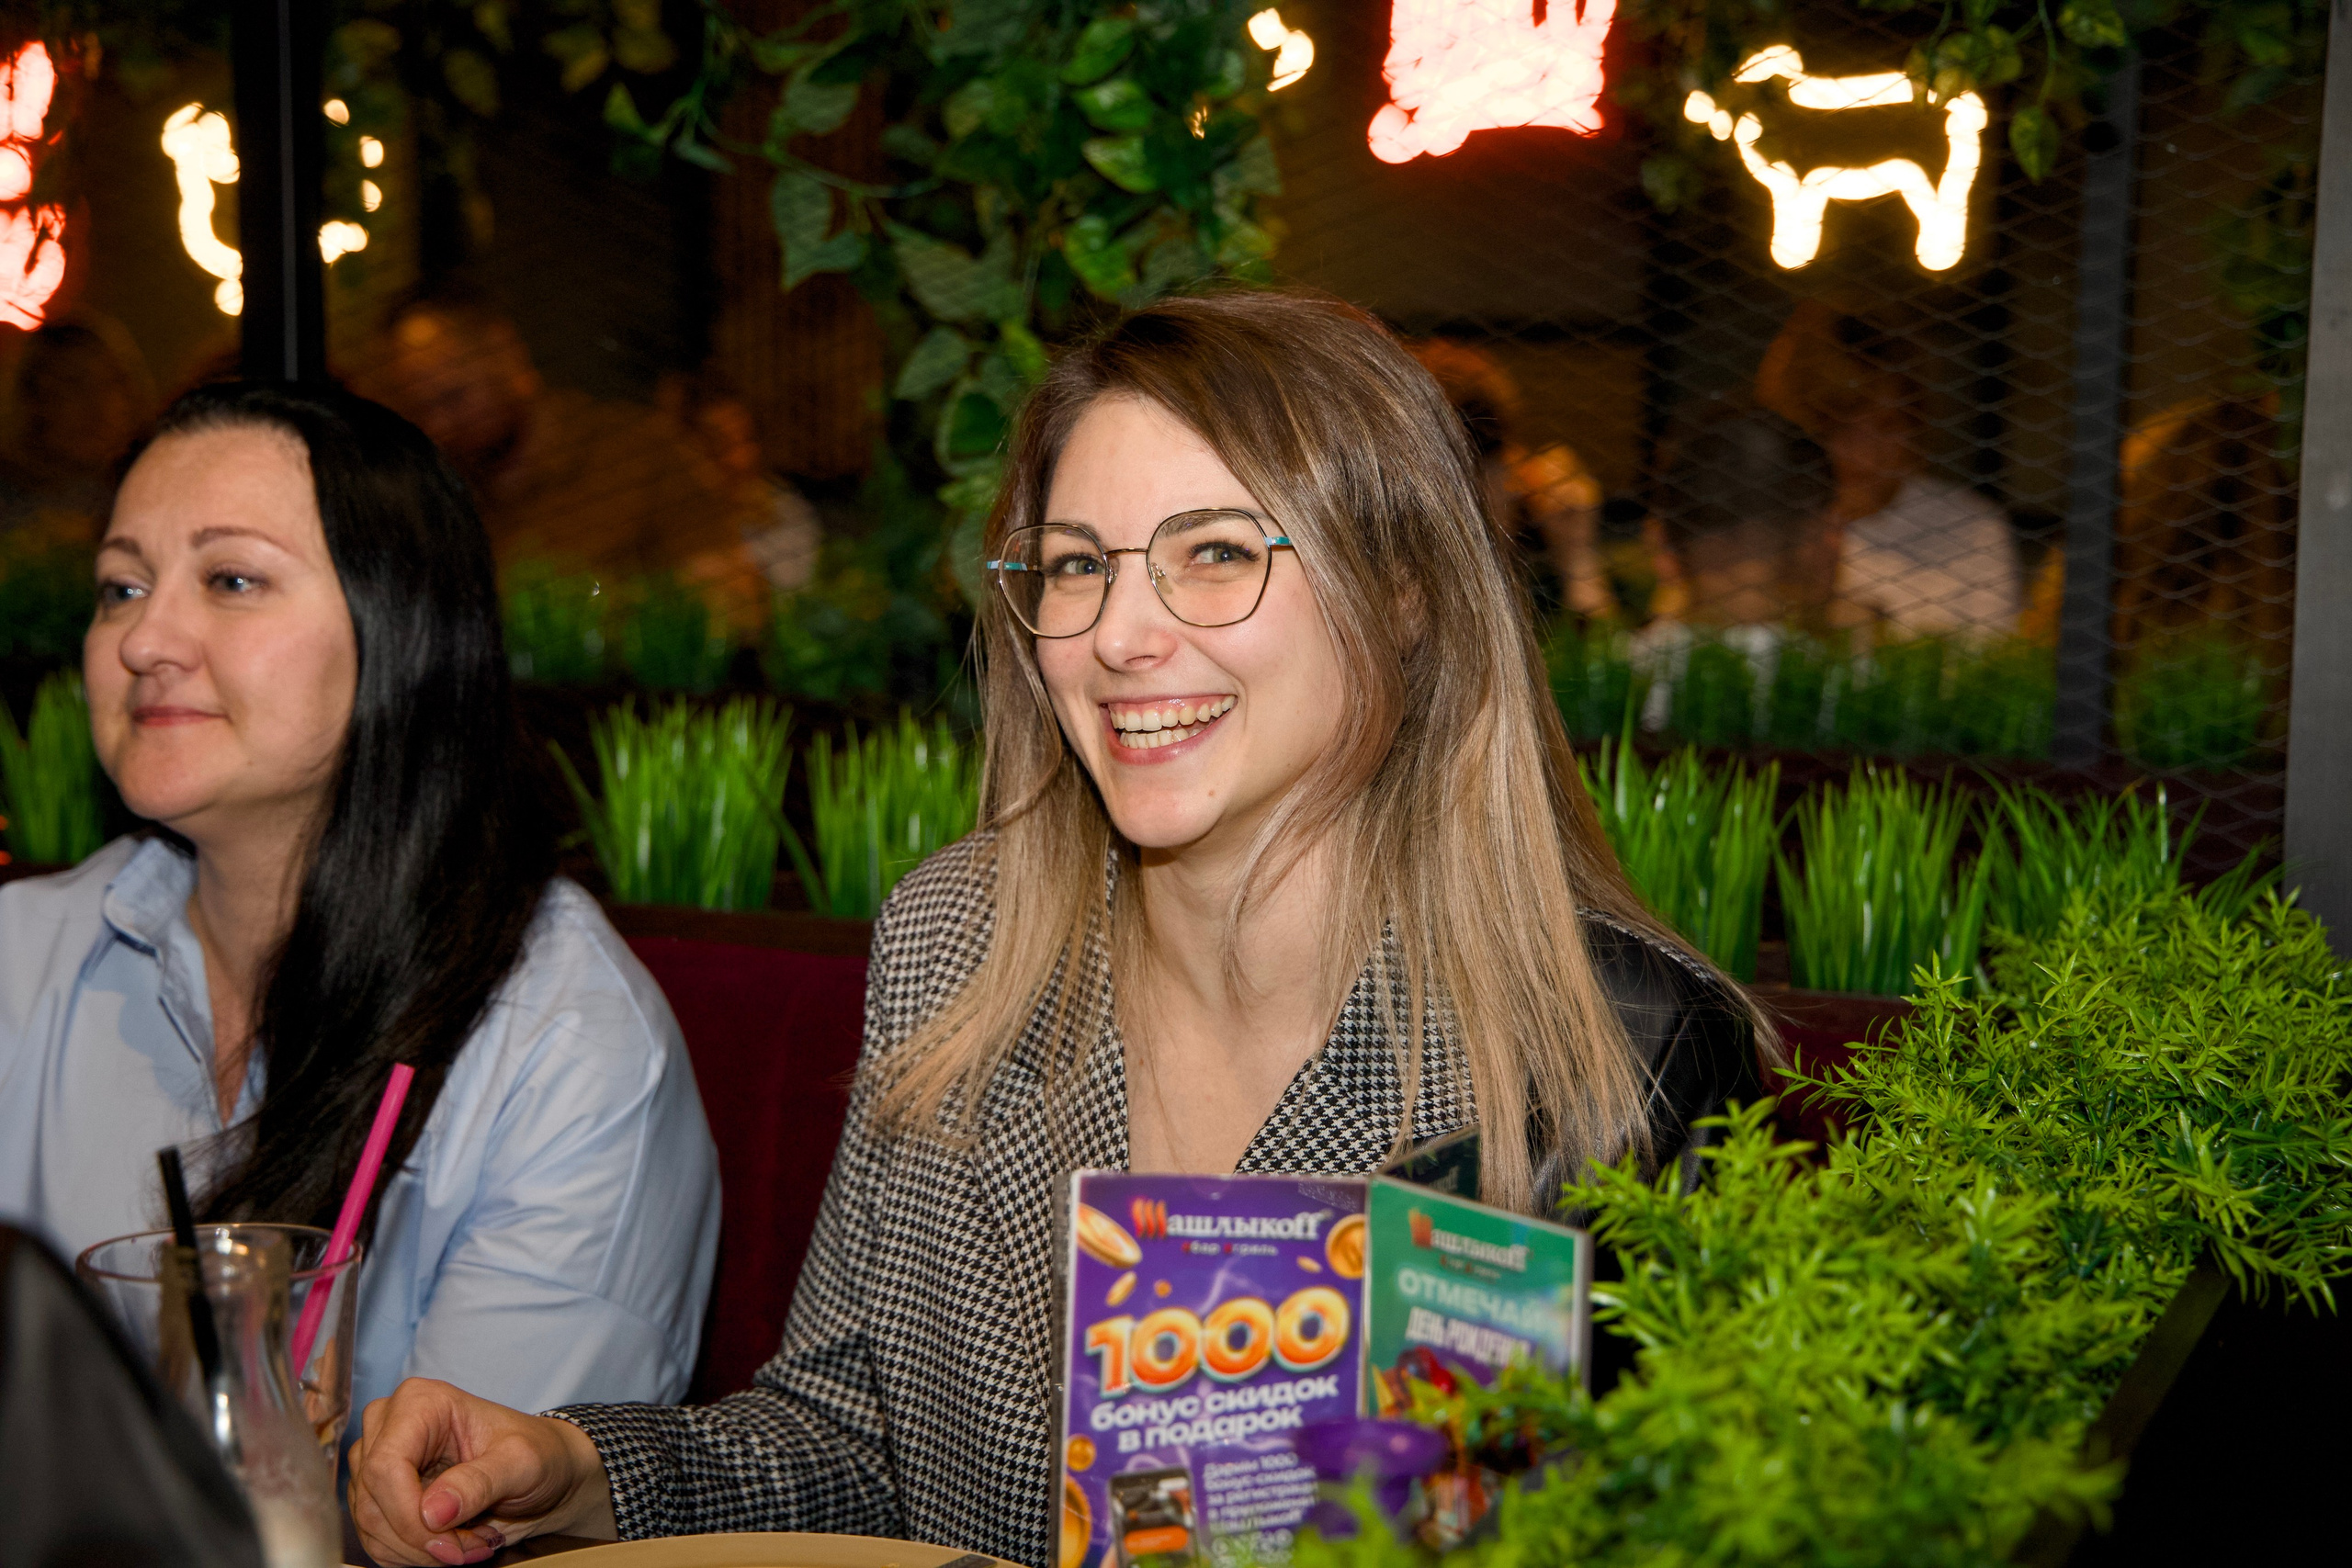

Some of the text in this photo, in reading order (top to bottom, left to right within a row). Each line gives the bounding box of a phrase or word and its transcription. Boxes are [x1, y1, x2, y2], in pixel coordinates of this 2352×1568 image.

[1085, 1286, 1350, 1398] 1000
[1091, 1375, 1339, 1432] бонус скидок
[1117, 1404, 1304, 1453] в подарок
